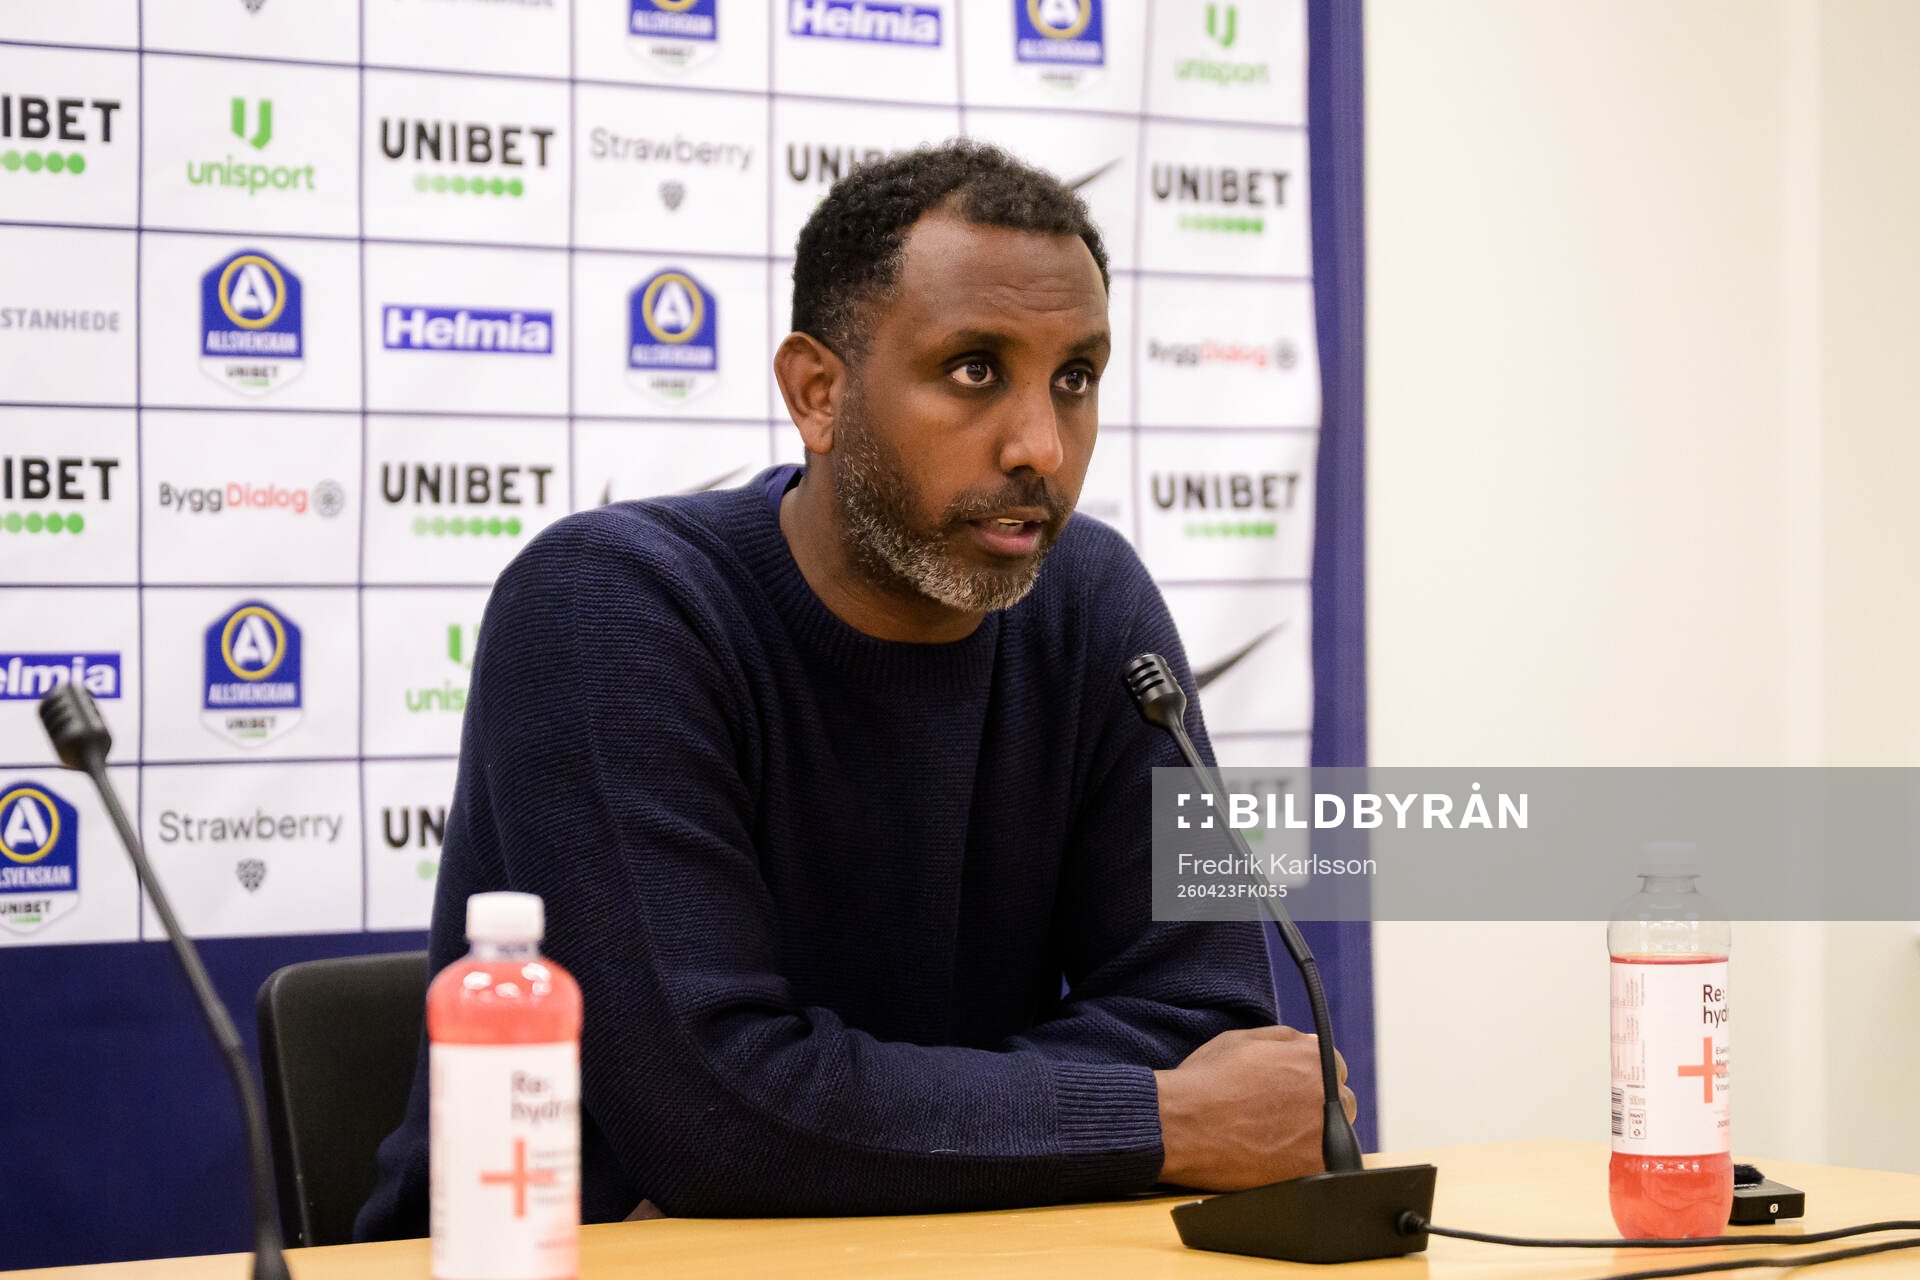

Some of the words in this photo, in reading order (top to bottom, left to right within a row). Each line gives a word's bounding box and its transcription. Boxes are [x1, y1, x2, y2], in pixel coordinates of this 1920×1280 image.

[794, 3, 938, 40] Helmia
[379, 117, 556, 169] UNIBET
[589, 127, 752, 172] Strawberry
[187, 153, 316, 196] unisport
[1151, 163, 1291, 207] UNIBET
[385, 307, 550, 350] Helmia
[380, 464, 553, 507] UNIBET
[1151, 472, 1301, 513] UNIBET
[158, 806, 344, 844] Strawberry
[0, 865, 72, 889] SVENSKAN
[1703, 983, 1726, 1004] Re:
[1702, 1005, 1729, 1029] hyd
